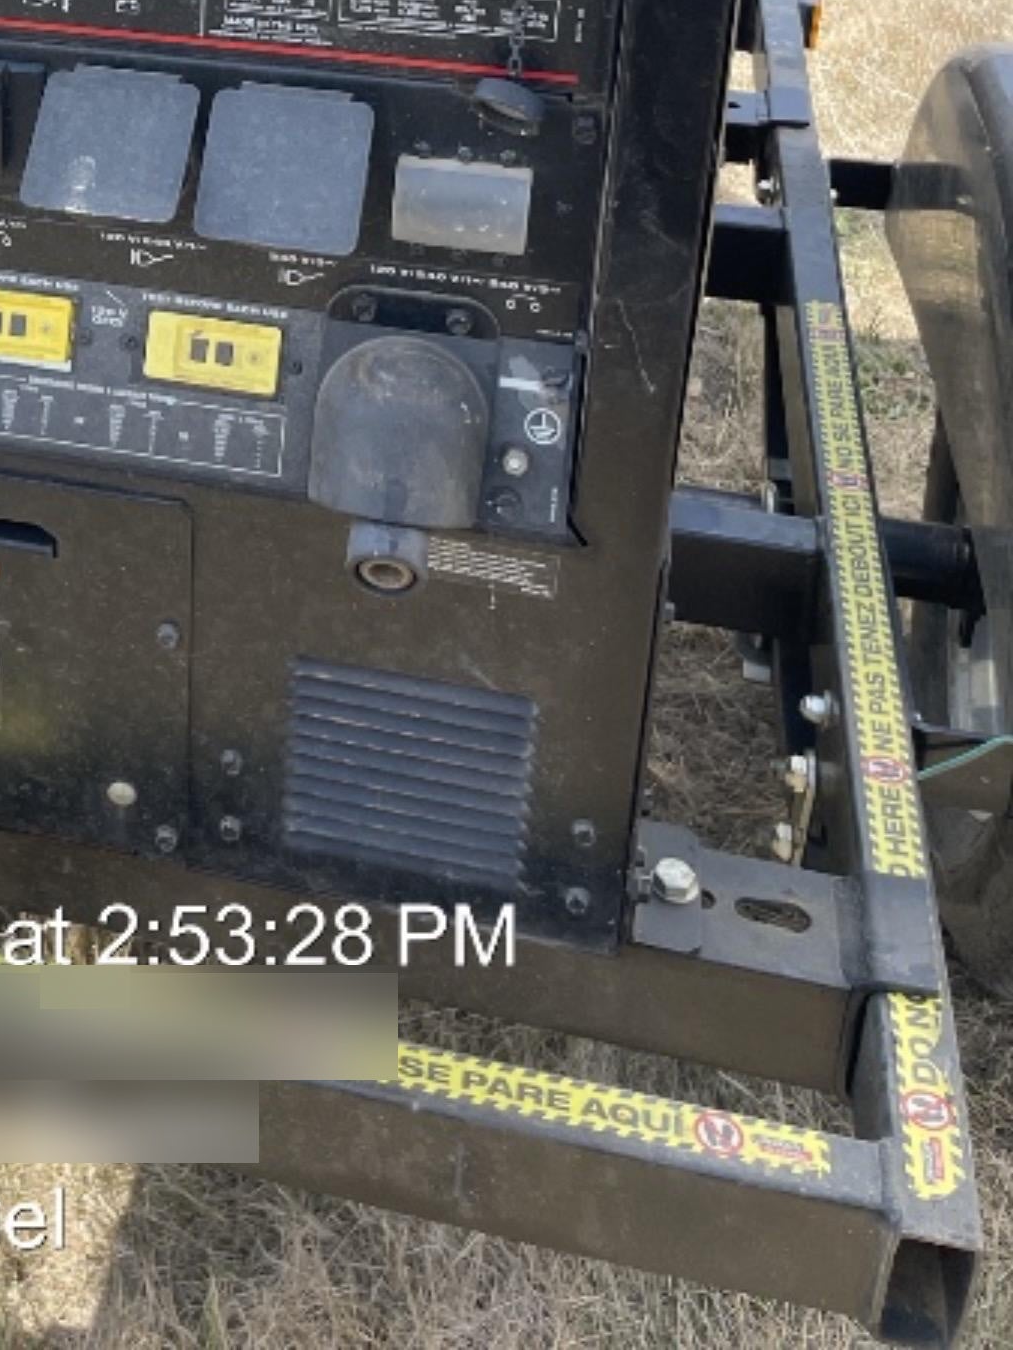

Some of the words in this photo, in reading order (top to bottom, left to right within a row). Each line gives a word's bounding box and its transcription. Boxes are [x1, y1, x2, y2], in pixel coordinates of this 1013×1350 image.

[826, 378, 846, 418] PARE
[832, 421, 850, 443] SE
[845, 491, 864, 515] ICI
[847, 516, 875, 599] DEBOUT
[856, 602, 884, 669] TENEZ
[865, 673, 887, 715] PAS
[873, 719, 895, 756] NE
[881, 786, 907, 852] HERE
[907, 1036, 937, 1084] DO
[398, 1055, 450, 1084] SE
[461, 1069, 571, 1112] PARE
